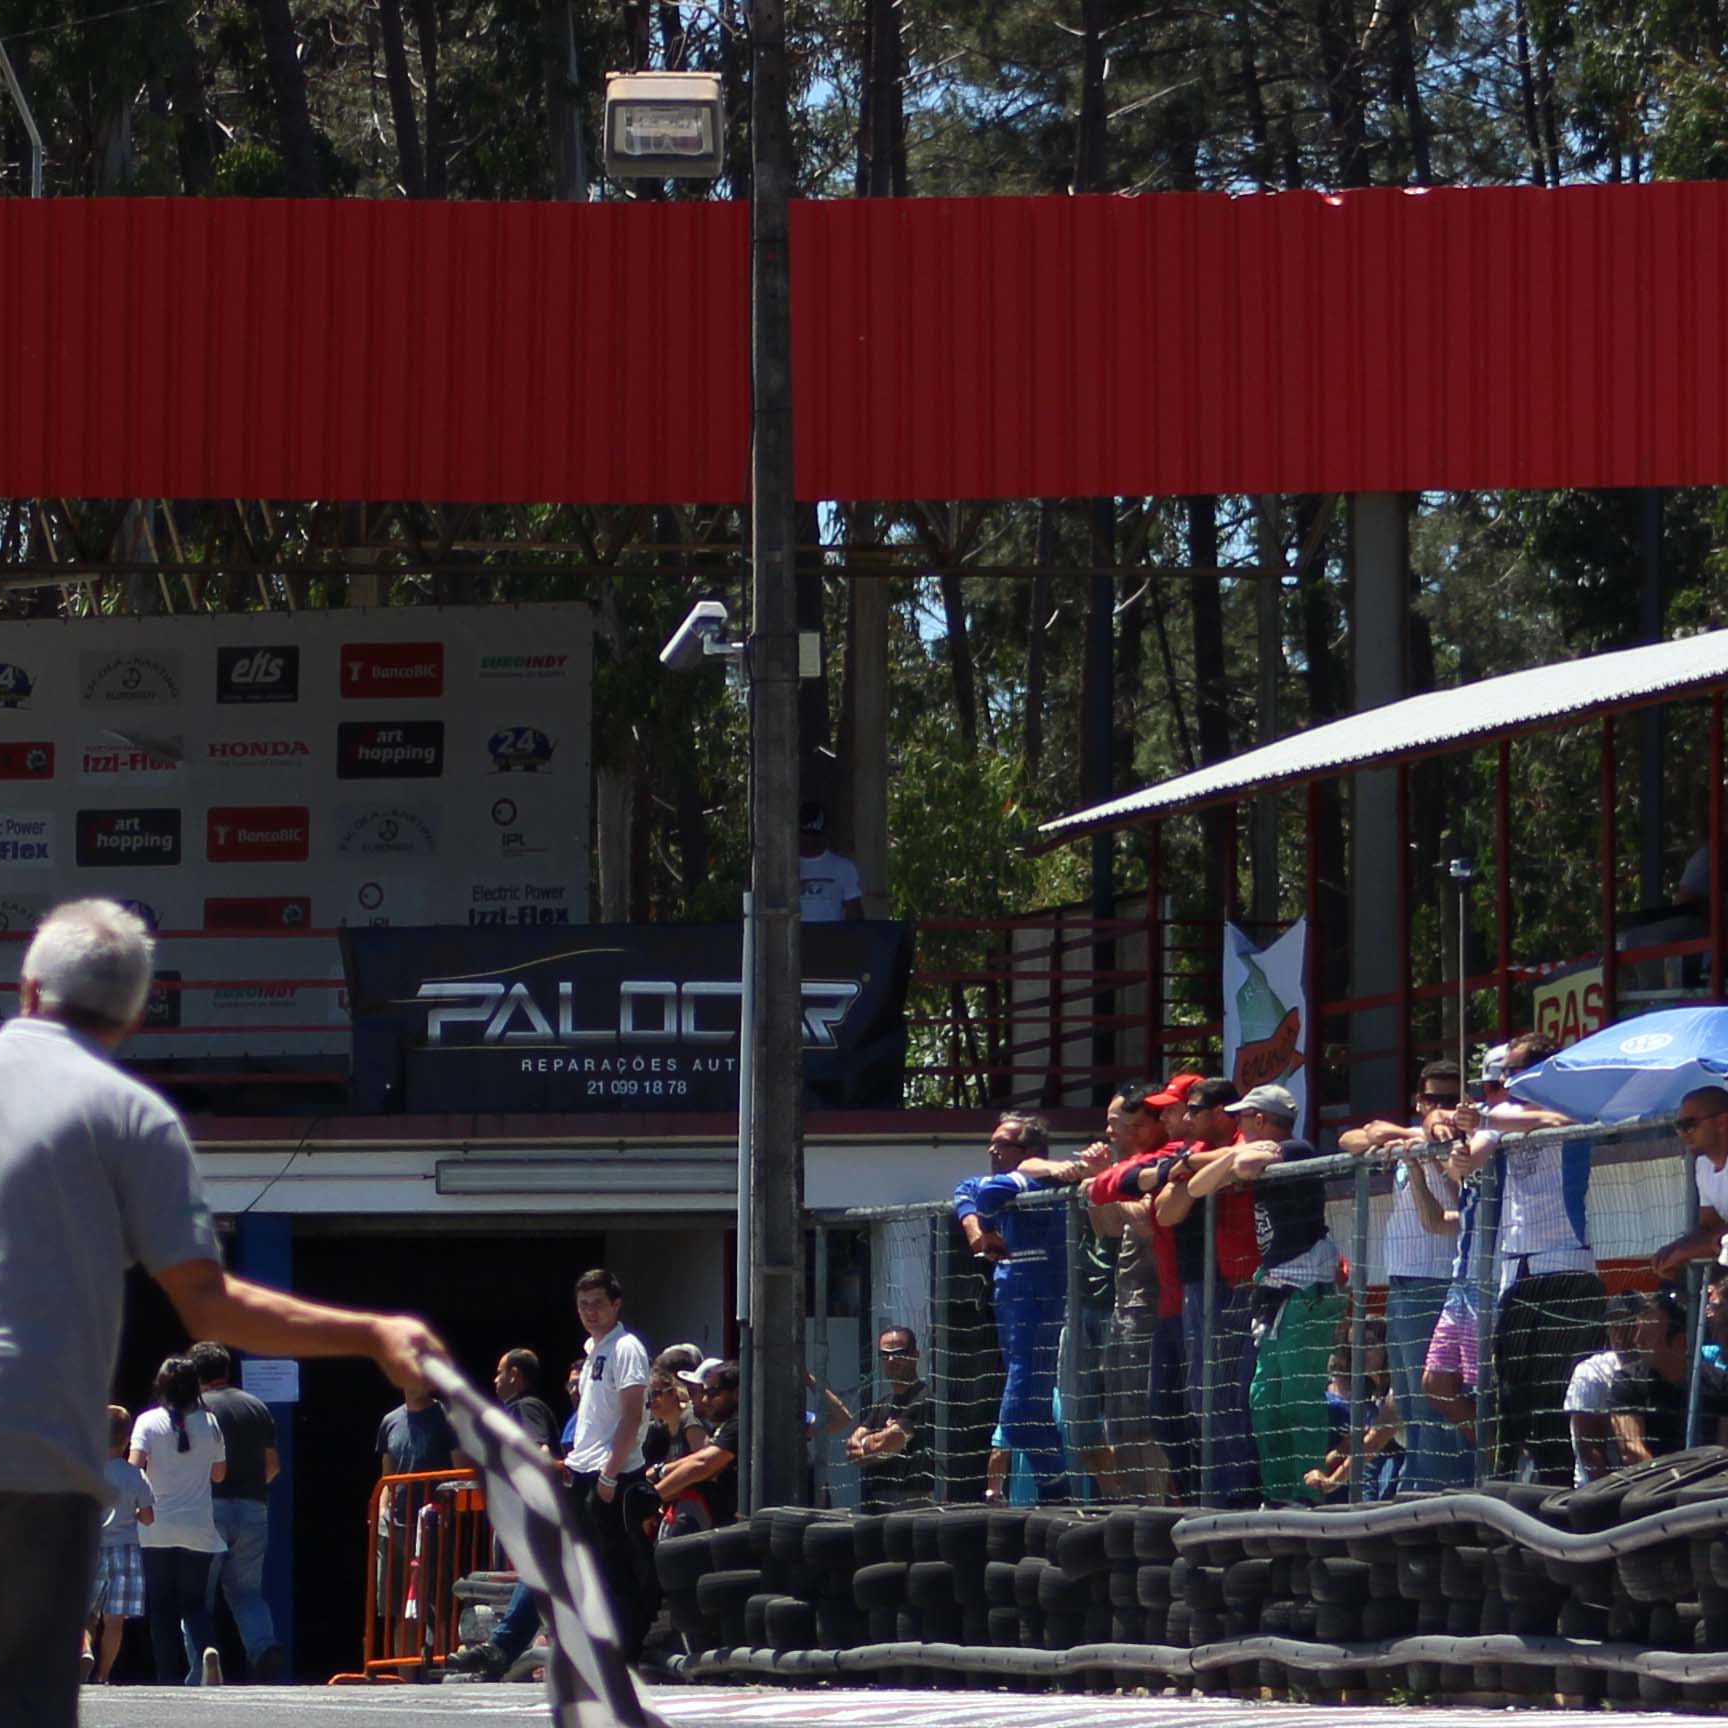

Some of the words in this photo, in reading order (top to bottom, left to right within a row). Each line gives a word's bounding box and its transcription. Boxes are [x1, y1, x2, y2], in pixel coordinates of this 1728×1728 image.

[208, 741, 311, 757] HONDA
[6, 818, 47, 835] Power
[502, 832, 526, 847] IPL
[472, 885, 519, 901] Electric
[525, 884, 566, 900] Power
[416, 980, 860, 1046] PALOCR
[1537, 982, 1605, 1046] GAS
[521, 1056, 678, 1076] REPARAÇÕES
[692, 1058, 736, 1073] AUT
[587, 1080, 607, 1096] 21
[610, 1080, 638, 1096] 099
[643, 1080, 663, 1096] 18
[667, 1080, 688, 1096] 78
